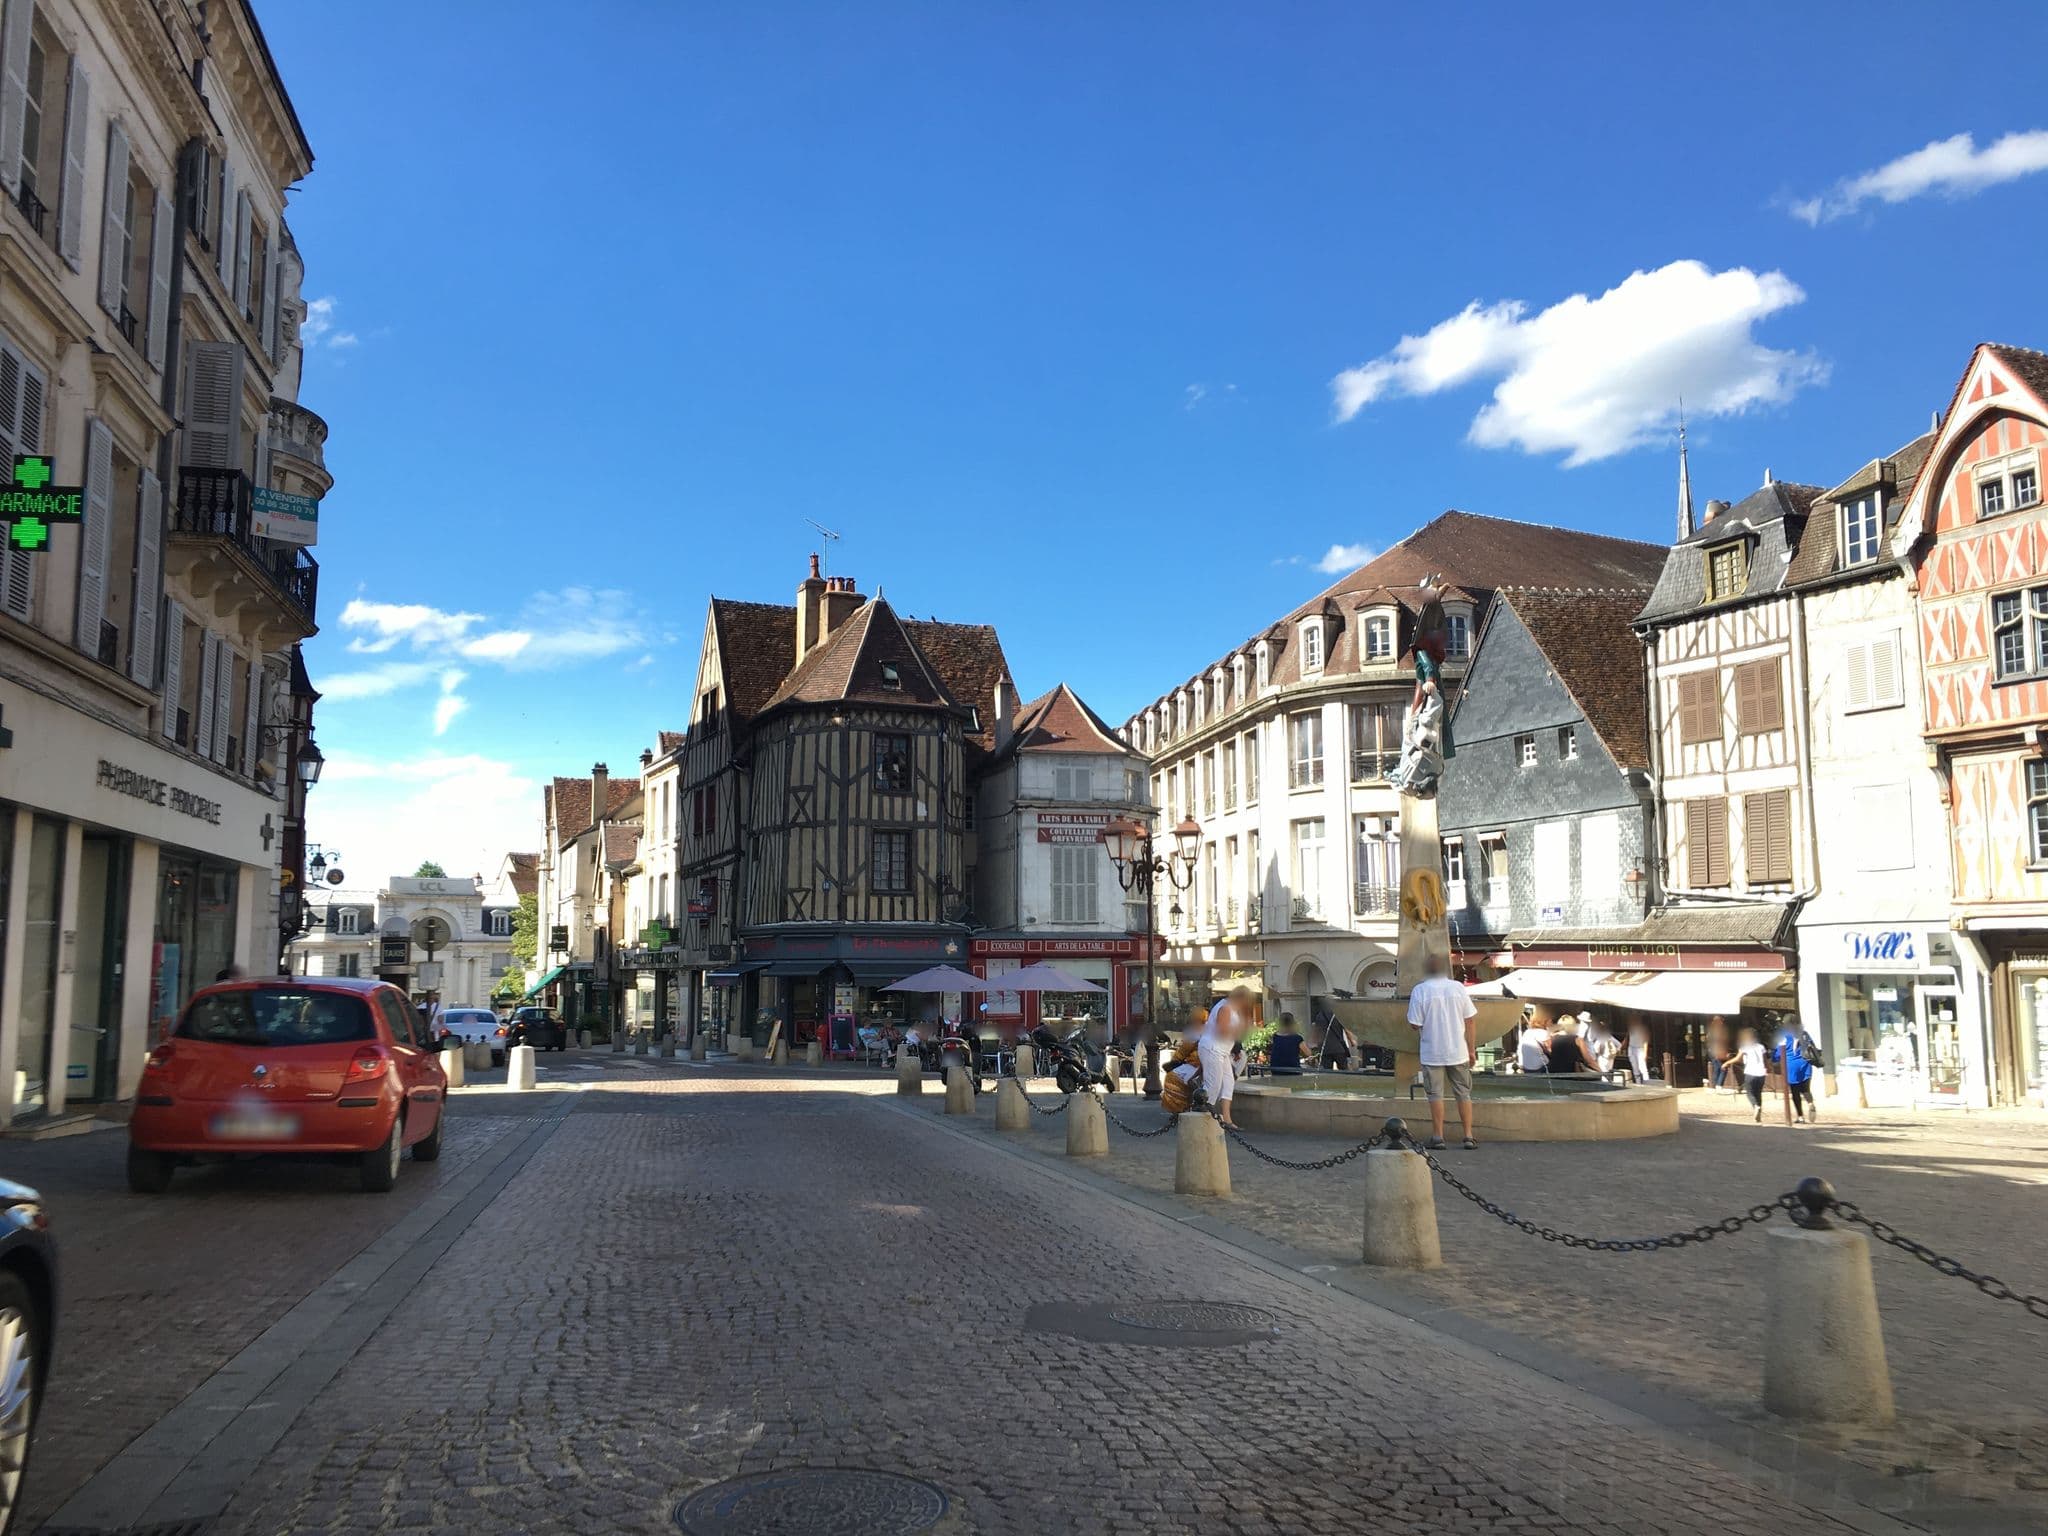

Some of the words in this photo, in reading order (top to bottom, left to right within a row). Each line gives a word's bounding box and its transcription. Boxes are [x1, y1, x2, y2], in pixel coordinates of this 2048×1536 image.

[0, 492, 82, 514] ARMACIE
[260, 490, 267, 498] A
[269, 491, 311, 506] VENDRE
[1041, 815, 1060, 823] ARTS
[1061, 815, 1072, 823] DE
[1073, 815, 1083, 823] LA
[1084, 815, 1108, 824] TABLE
[1049, 828, 1098, 836] COUTELLERIE
[419, 881, 447, 892] LCL
[1055, 942, 1069, 950] ARTS
[1069, 942, 1078, 950] DE
[1078, 942, 1087, 950] LA
[1087, 942, 1105, 951] TABLE
[1588, 943, 1633, 956] Olivier
[1844, 931, 1916, 960] Will's
[384, 949, 405, 958] TAXIS
[1368, 978, 1398, 988] euro
